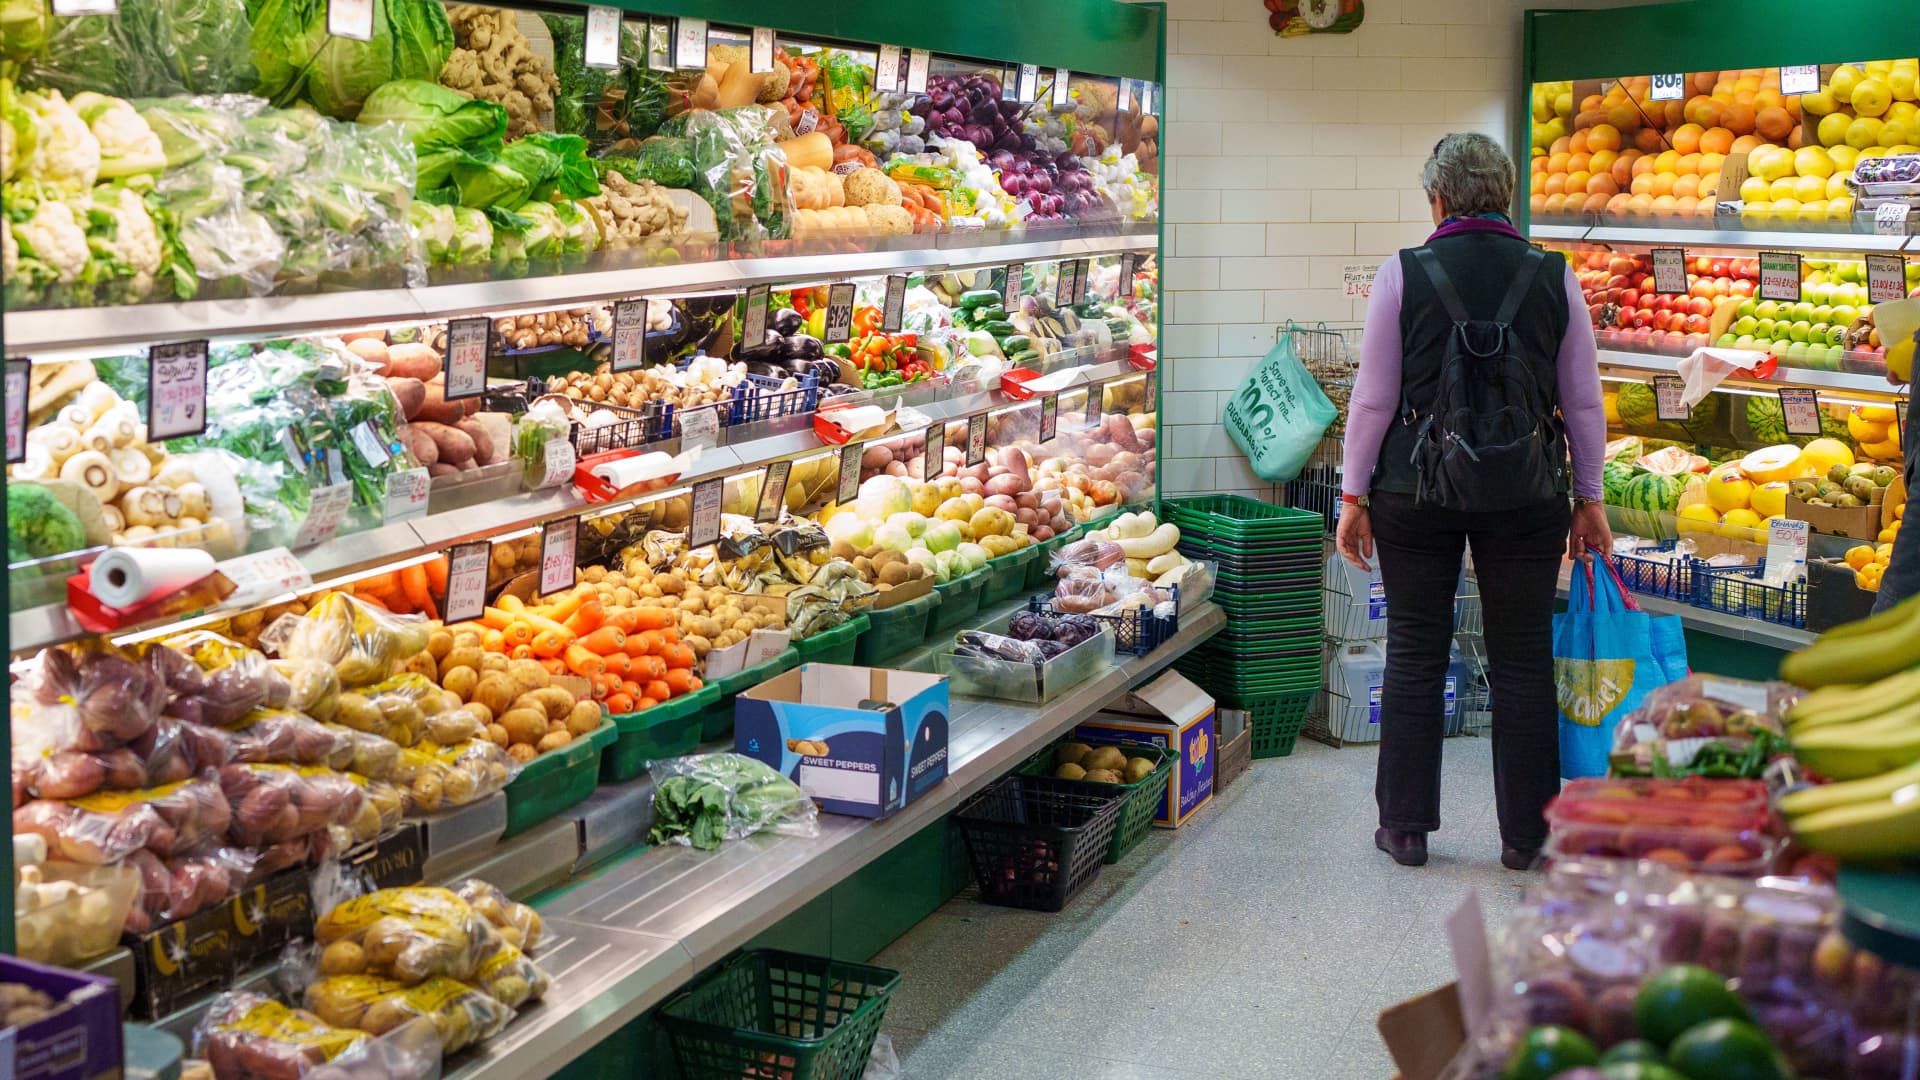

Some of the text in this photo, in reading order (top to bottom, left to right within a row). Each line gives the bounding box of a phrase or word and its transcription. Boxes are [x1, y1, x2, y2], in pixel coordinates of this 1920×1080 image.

[1269, 361, 1286, 387] Save
[803, 757, 877, 772] SWEET PEPPERS
[911, 746, 947, 778] SWEET PEPPERS
